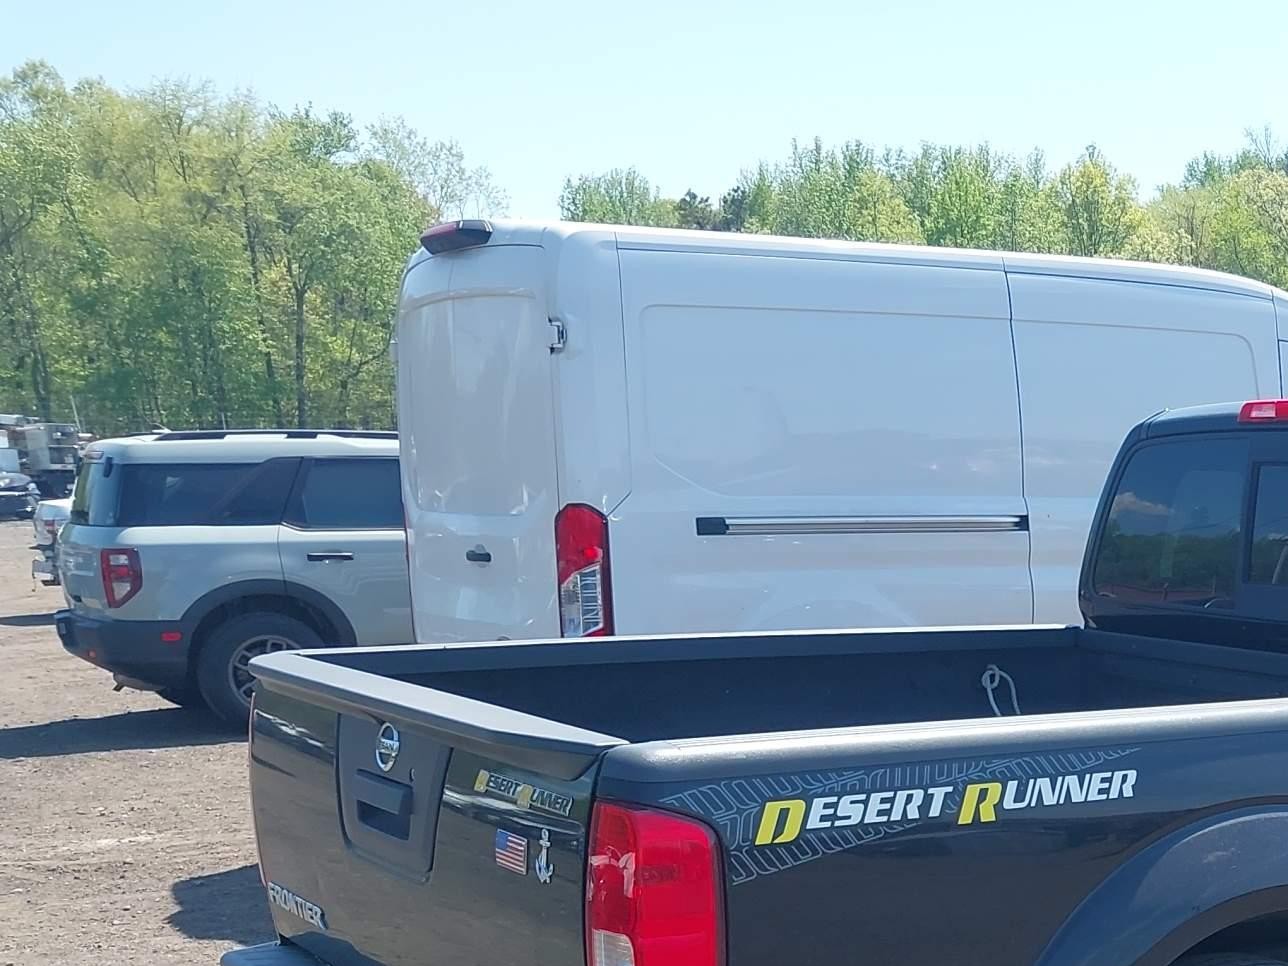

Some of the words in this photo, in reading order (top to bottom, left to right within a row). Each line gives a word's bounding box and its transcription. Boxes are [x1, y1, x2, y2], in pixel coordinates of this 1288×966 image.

[754, 786, 953, 845] DESERT
[958, 769, 1137, 825] RUNNER
[268, 882, 326, 929] FRONTIER
